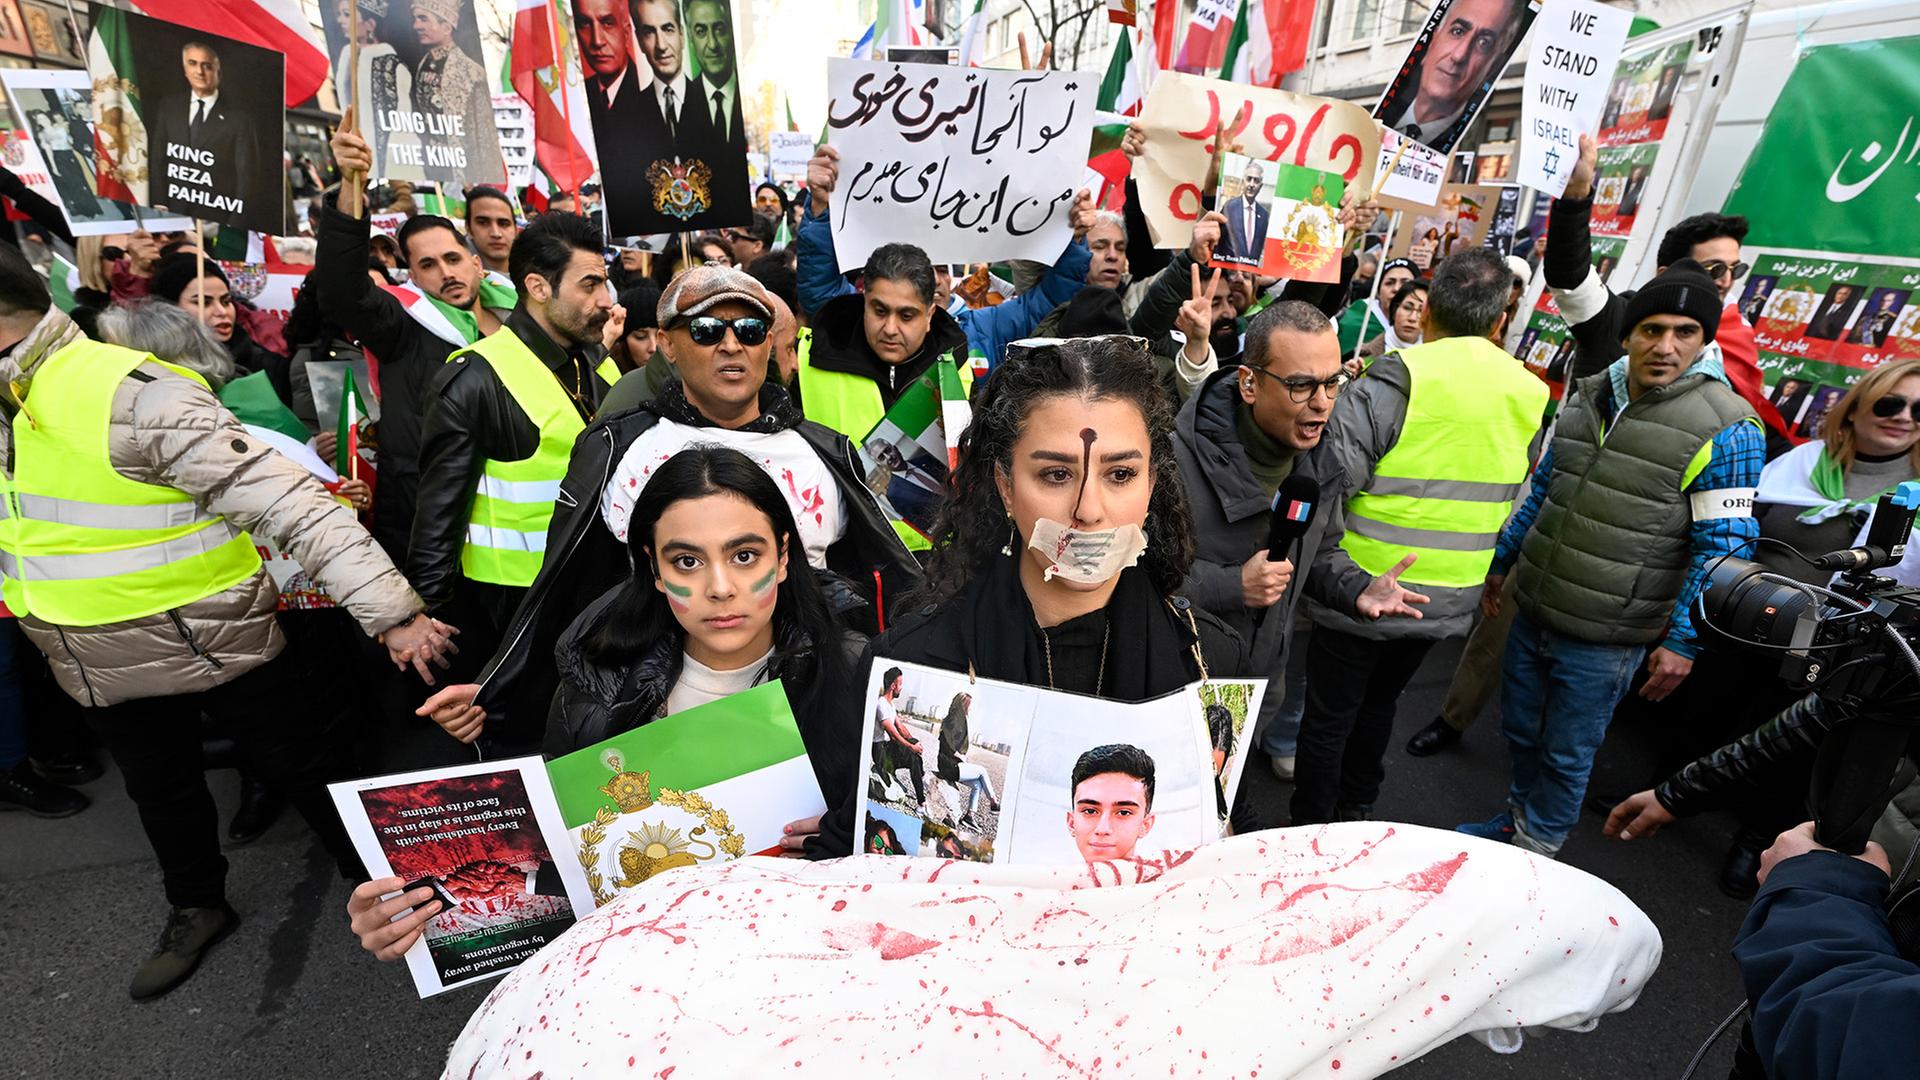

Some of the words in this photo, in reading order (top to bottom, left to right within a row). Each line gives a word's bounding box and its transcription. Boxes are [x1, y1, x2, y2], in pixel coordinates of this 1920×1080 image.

[1569, 10, 1598, 36] WE
[1542, 45, 1598, 77] STAND
[1540, 83, 1578, 112] WITH
[378, 109, 425, 134] LONG
[426, 113, 466, 136] LIVE
[972, 72, 1051, 164] آنجا
[1028, 82, 1079, 153] تو
[1534, 118, 1574, 148] ISRAEL
[166, 142, 215, 166] KING
[387, 143, 425, 165] THE
[425, 145, 468, 168] KING
[167, 163, 213, 187] REZA
[168, 183, 244, 214] PAHLAVI
[1006, 188, 1073, 236] من
[1799, 261, 1838, 278] آخرین
[1833, 266, 1859, 281] این
[446, 803, 462, 812] its
[463, 800, 474, 810] of
[477, 797, 500, 808] face
[398, 805, 446, 818] victims.
[464, 810, 502, 823] regime
[504, 807, 527, 818] this
[405, 822, 418, 832] in
[418, 818, 442, 830] slap
[444, 818, 452, 826] a
[451, 816, 463, 825] is
[487, 821, 519, 832] Every
[384, 826, 404, 835] the
[424, 826, 486, 842] handshake
[395, 836, 423, 847] with
[531, 935, 545, 946] by
[461, 938, 530, 960] negotiations.
[515, 950, 538, 961] isn't
[475, 953, 514, 971] washed
[444, 964, 472, 979] away
